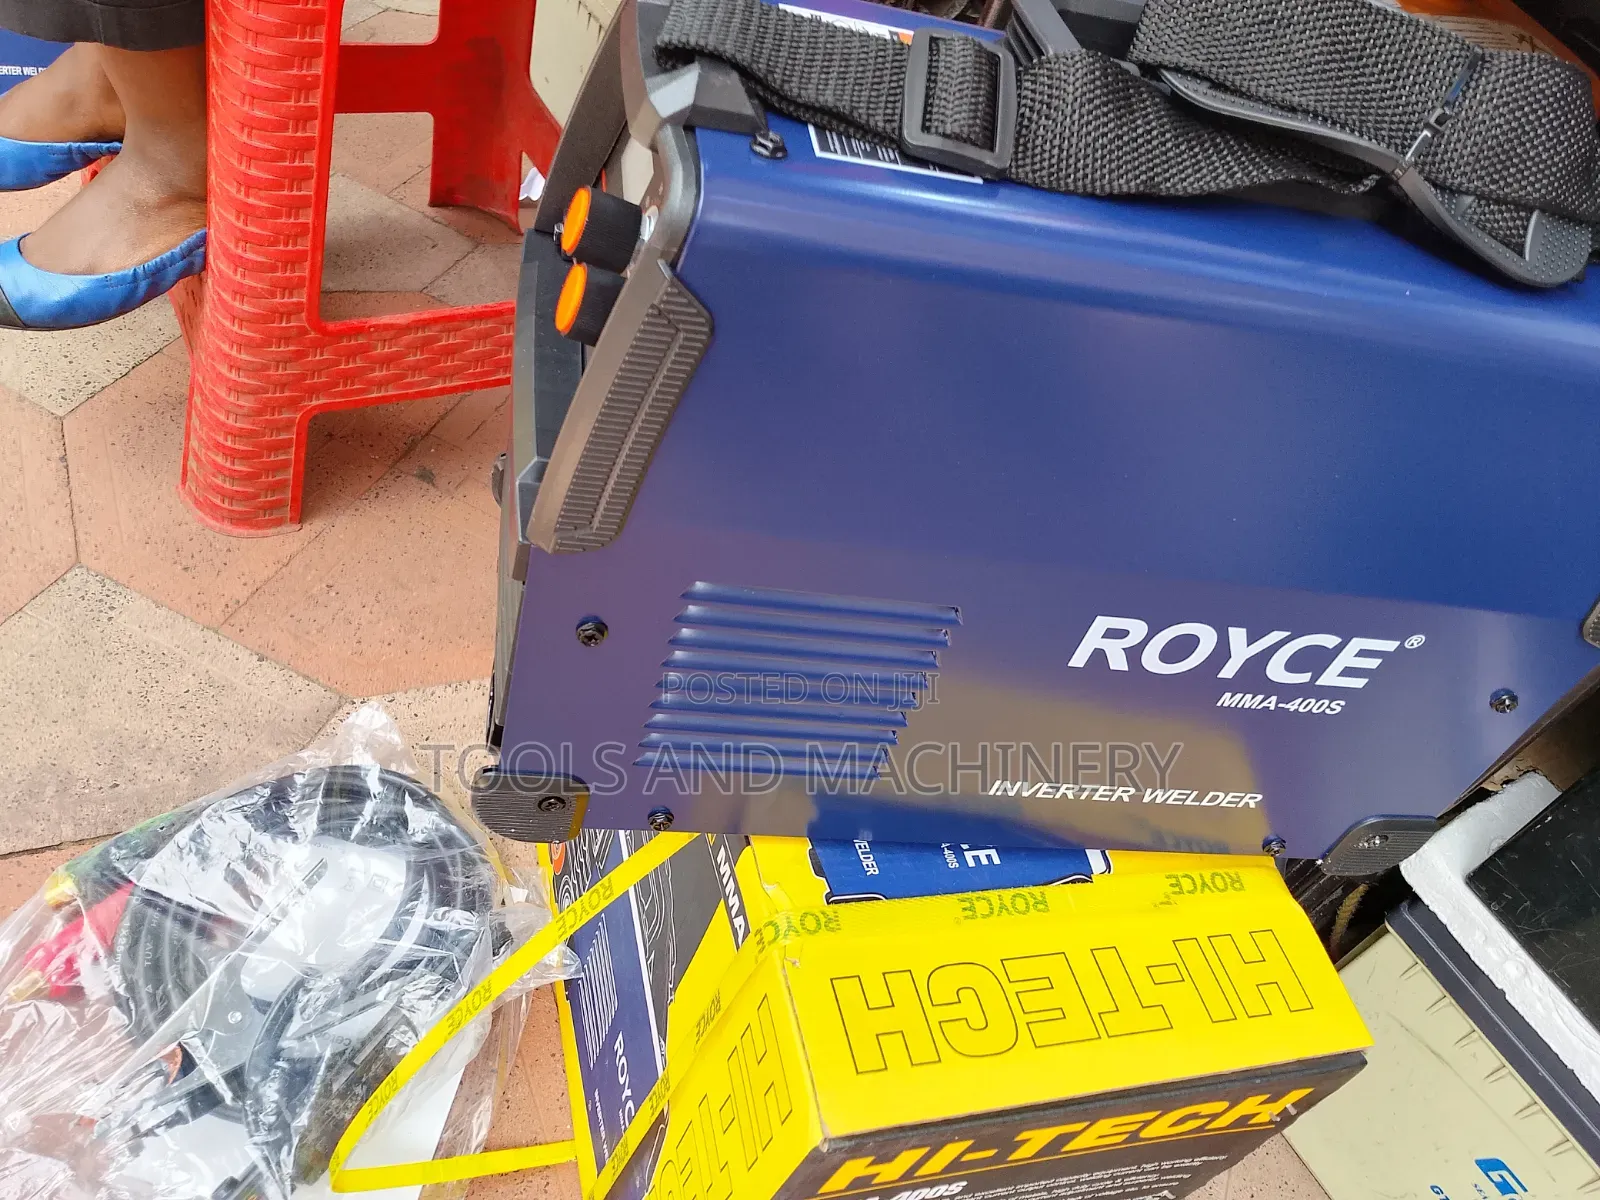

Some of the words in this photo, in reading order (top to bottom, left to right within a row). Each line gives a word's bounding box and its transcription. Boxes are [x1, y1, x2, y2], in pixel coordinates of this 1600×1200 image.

[1216, 692, 1346, 715] MMA-400S
[988, 779, 1136, 803] INVERTER
[1142, 786, 1264, 809] WELDER
[853, 839, 880, 876] ELDER
[1168, 871, 1244, 897] ROYCE
[556, 877, 614, 940] ROYCE
[717, 845, 746, 948] MMA
[961, 890, 1050, 921] ROYCE
[446, 980, 493, 1037] ROYCE
[830, 929, 1314, 1075] HI-TECH
[365, 1072, 398, 1128] ROYCE
[644, 993, 793, 1200] HI-TE
[817, 1088, 1315, 1194] HI-TECH
